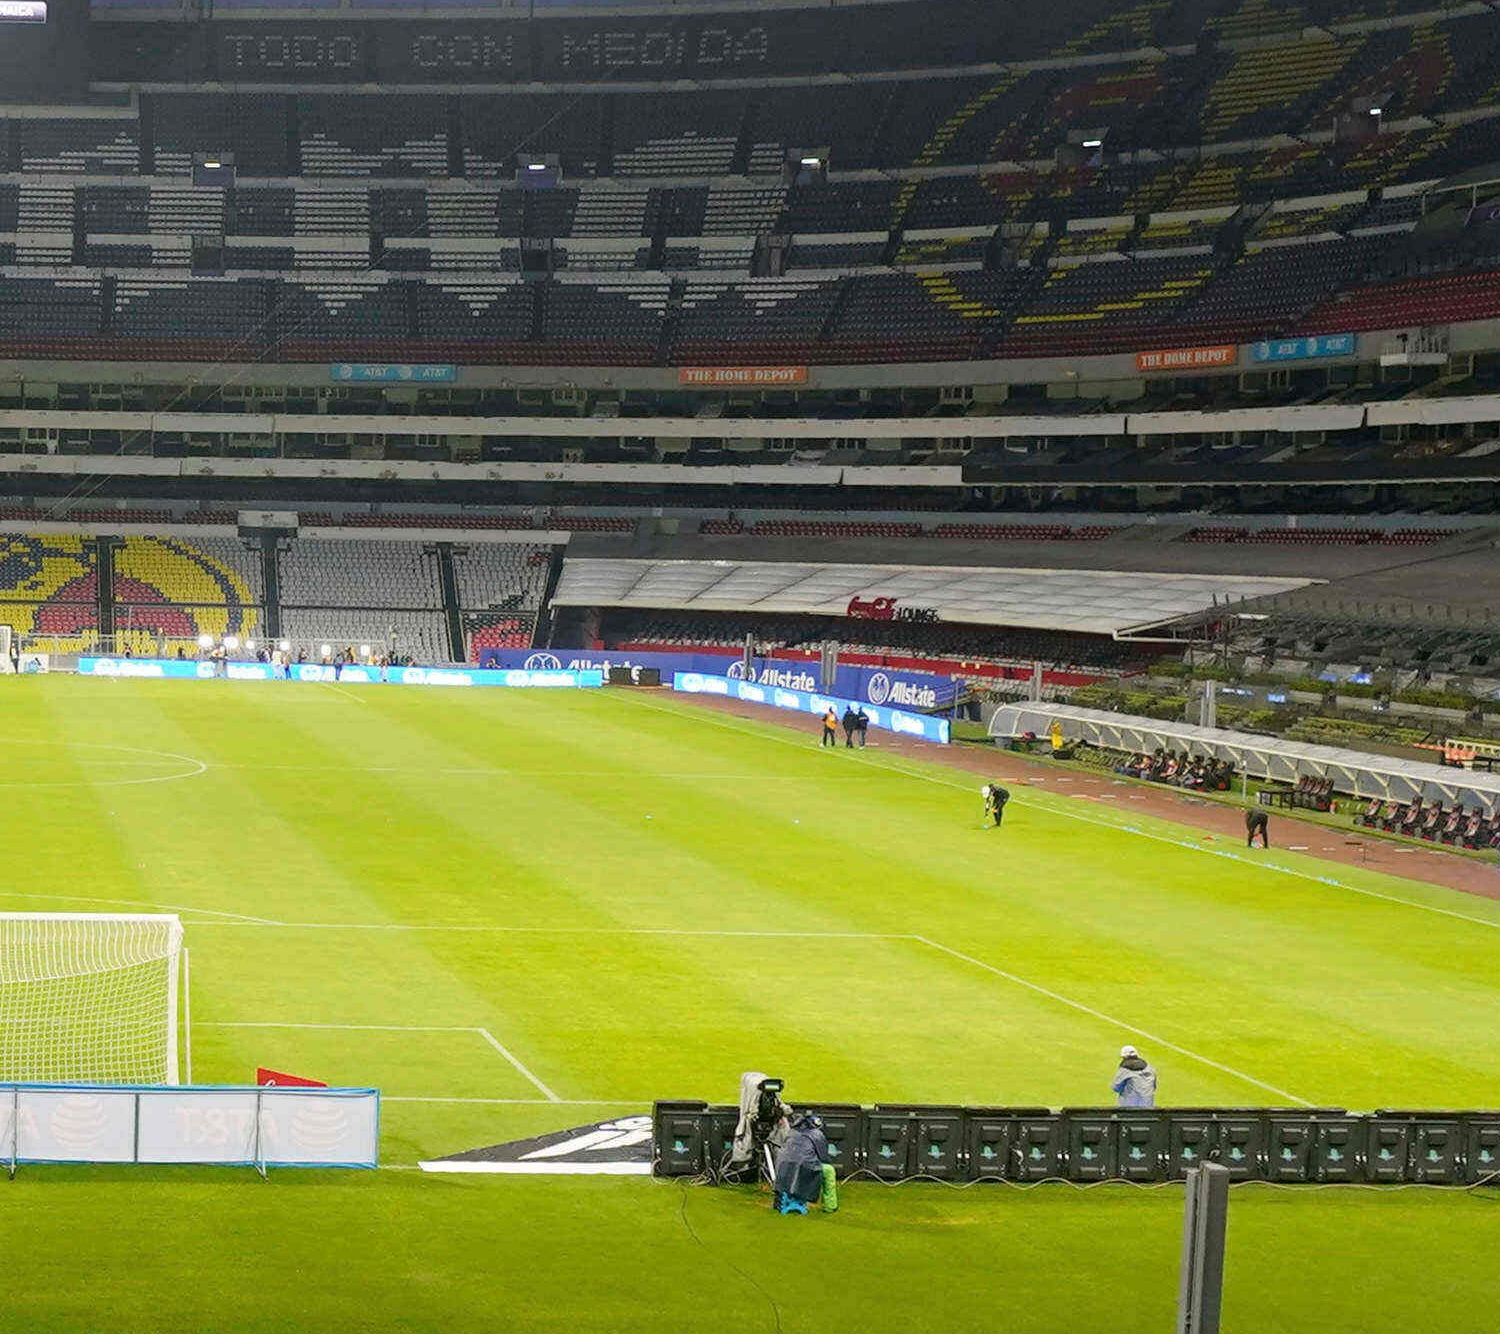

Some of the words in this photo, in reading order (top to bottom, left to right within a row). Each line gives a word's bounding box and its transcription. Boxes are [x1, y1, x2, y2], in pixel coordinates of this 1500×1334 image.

[686, 370, 713, 381] THE
[715, 370, 752, 381] HOME
[755, 369, 797, 381] DEPOT
[758, 667, 815, 692] Allstate
